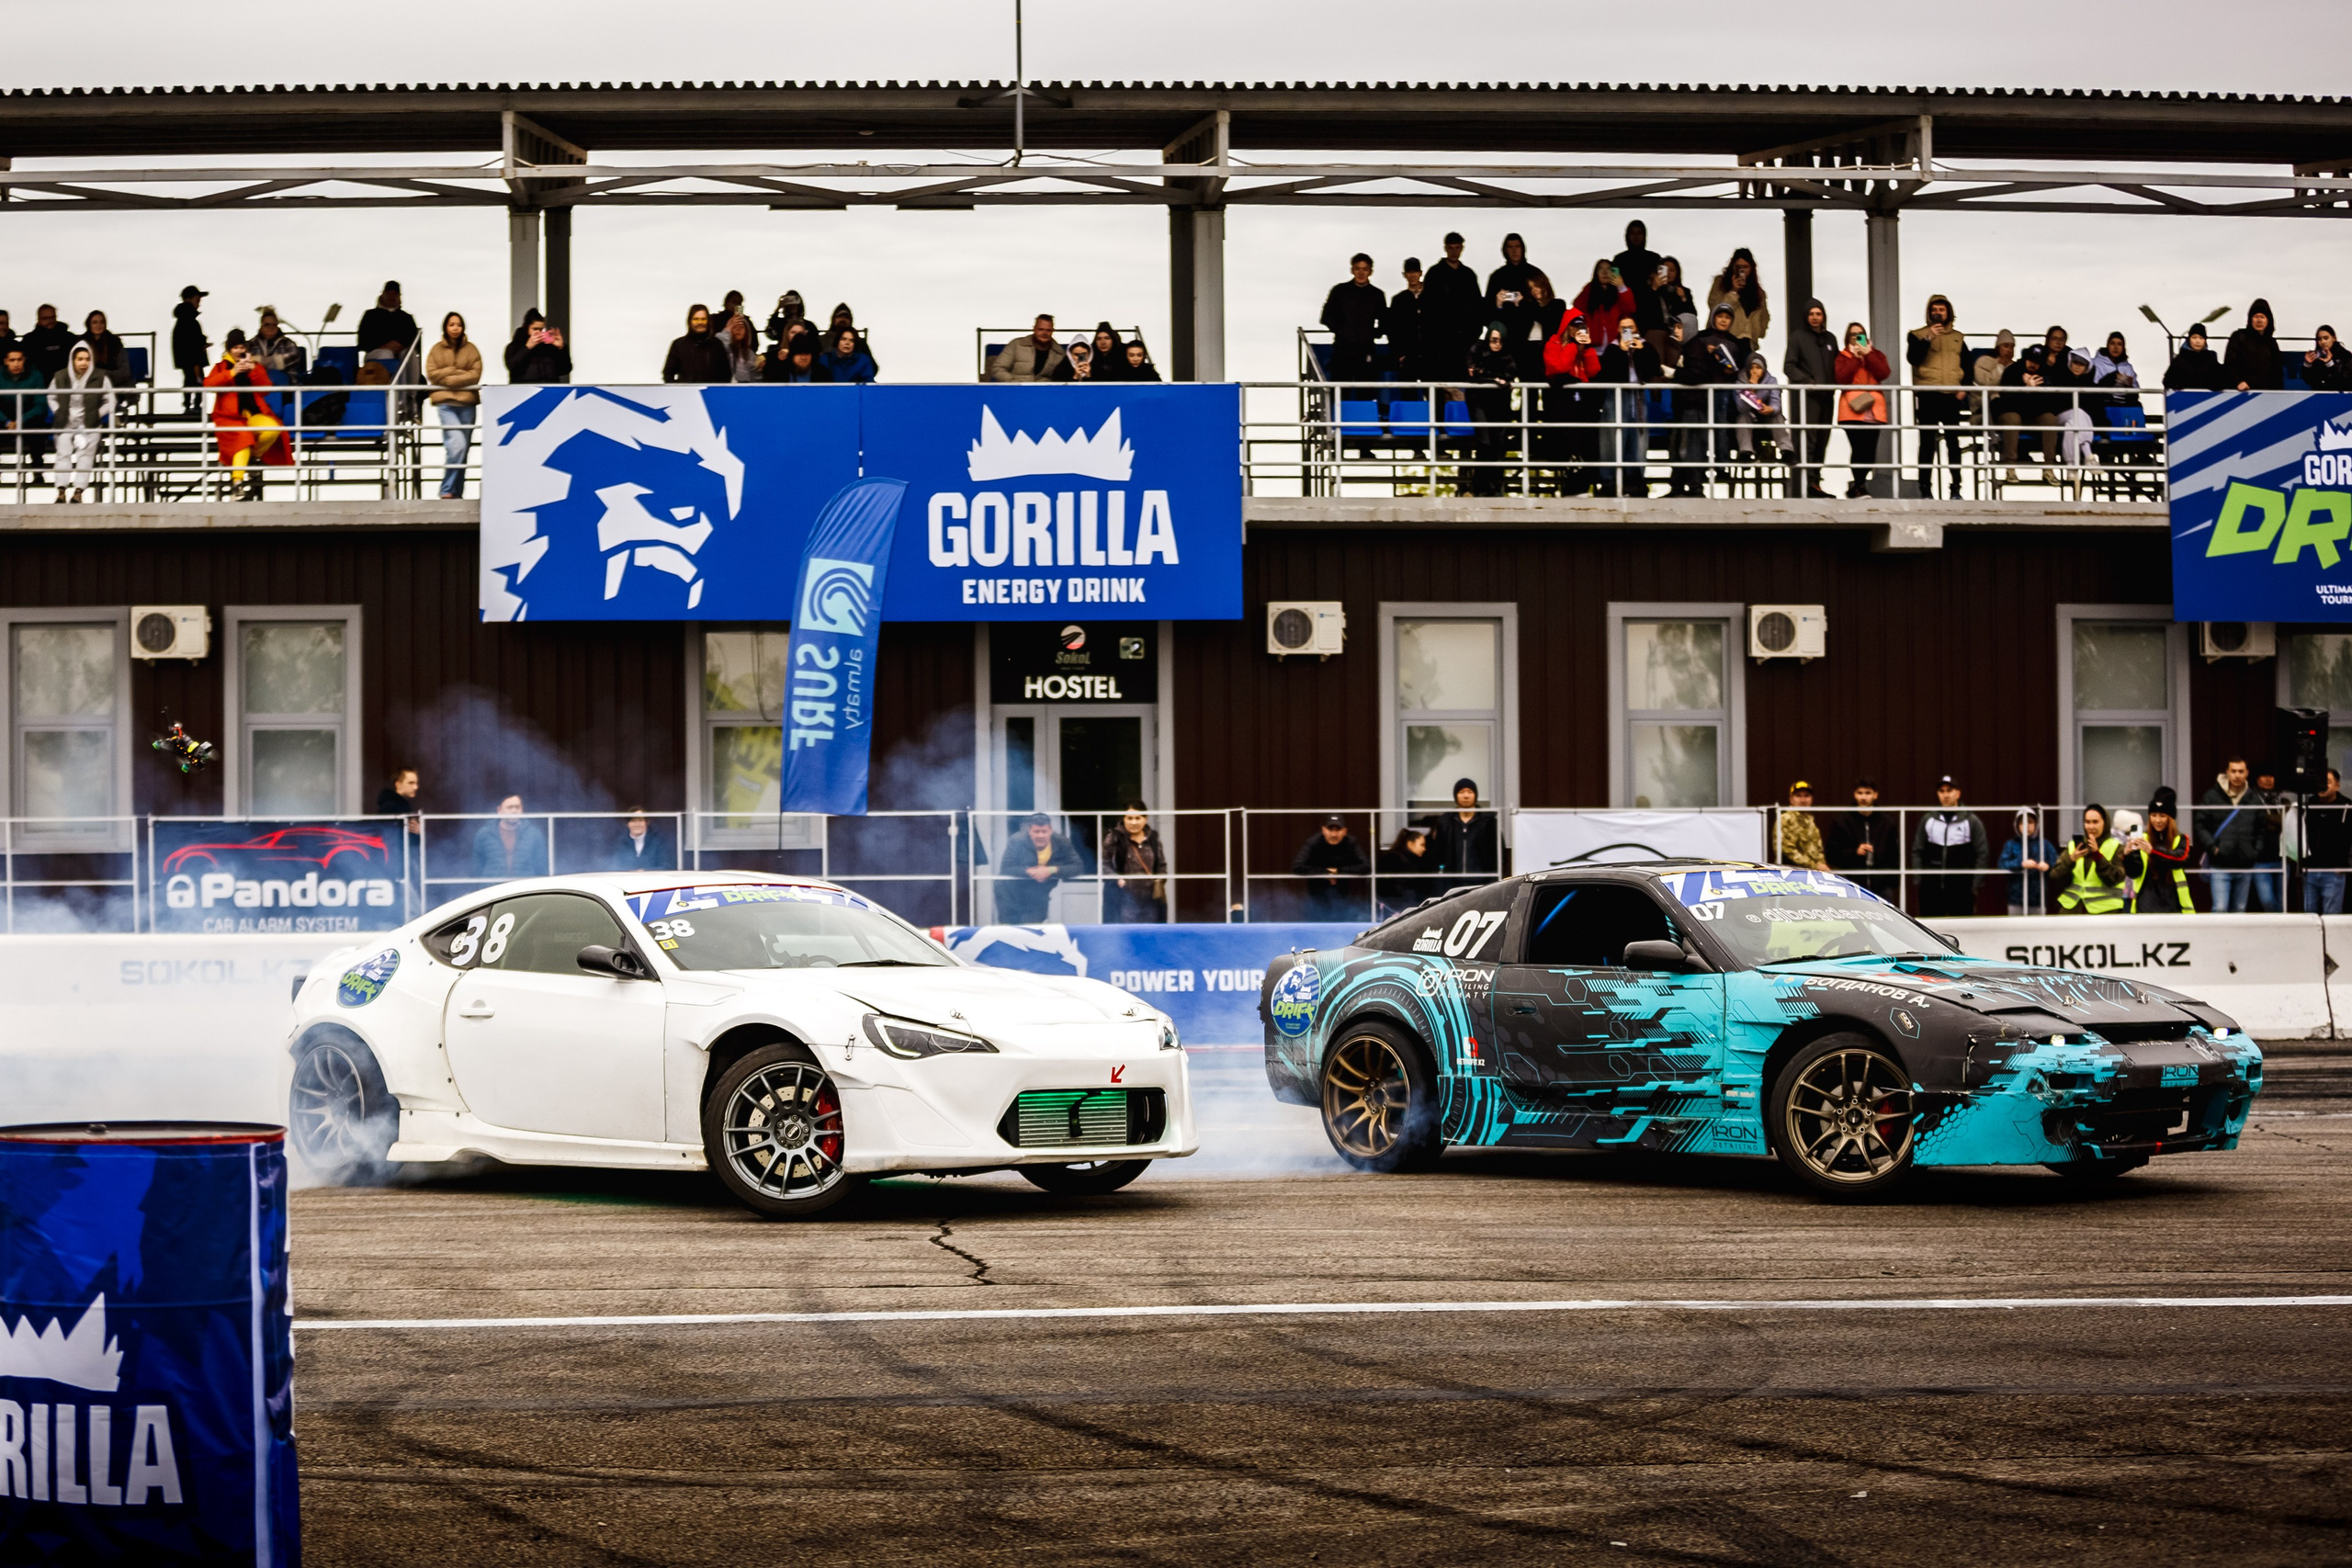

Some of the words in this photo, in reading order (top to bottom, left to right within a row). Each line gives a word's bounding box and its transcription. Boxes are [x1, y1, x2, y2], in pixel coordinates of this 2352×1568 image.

[928, 490, 1180, 567] GORILLA
[2205, 481, 2352, 570] DR
[962, 579, 1062, 604] ENERGY
[1068, 578, 1146, 603] DRINK
[1024, 675, 1123, 698] HOSTEL
[200, 872, 394, 908] Pandora
[1688, 901, 1725, 921] 07
[202, 917, 234, 933] CAR
[238, 917, 292, 933] ALARM
[295, 917, 359, 932] SYSTEM
[648, 919, 695, 941] 38
[1443, 909, 1509, 959] 07
[451, 913, 515, 965] 38
[1412, 938, 1442, 953] GORILLA
[2006, 942, 2191, 969] SOKOL.KZ
[1110, 970, 1194, 992] POWER
[1202, 970, 1265, 991] YOUR
[1443, 968, 1496, 982] IRON
[1804, 977, 1910, 1000] БОГДАНОВ
[1712, 1125, 1758, 1140] IRON
[1713, 1142, 1758, 1151] DETAILING
[0, 1398, 183, 1506] RILLA
